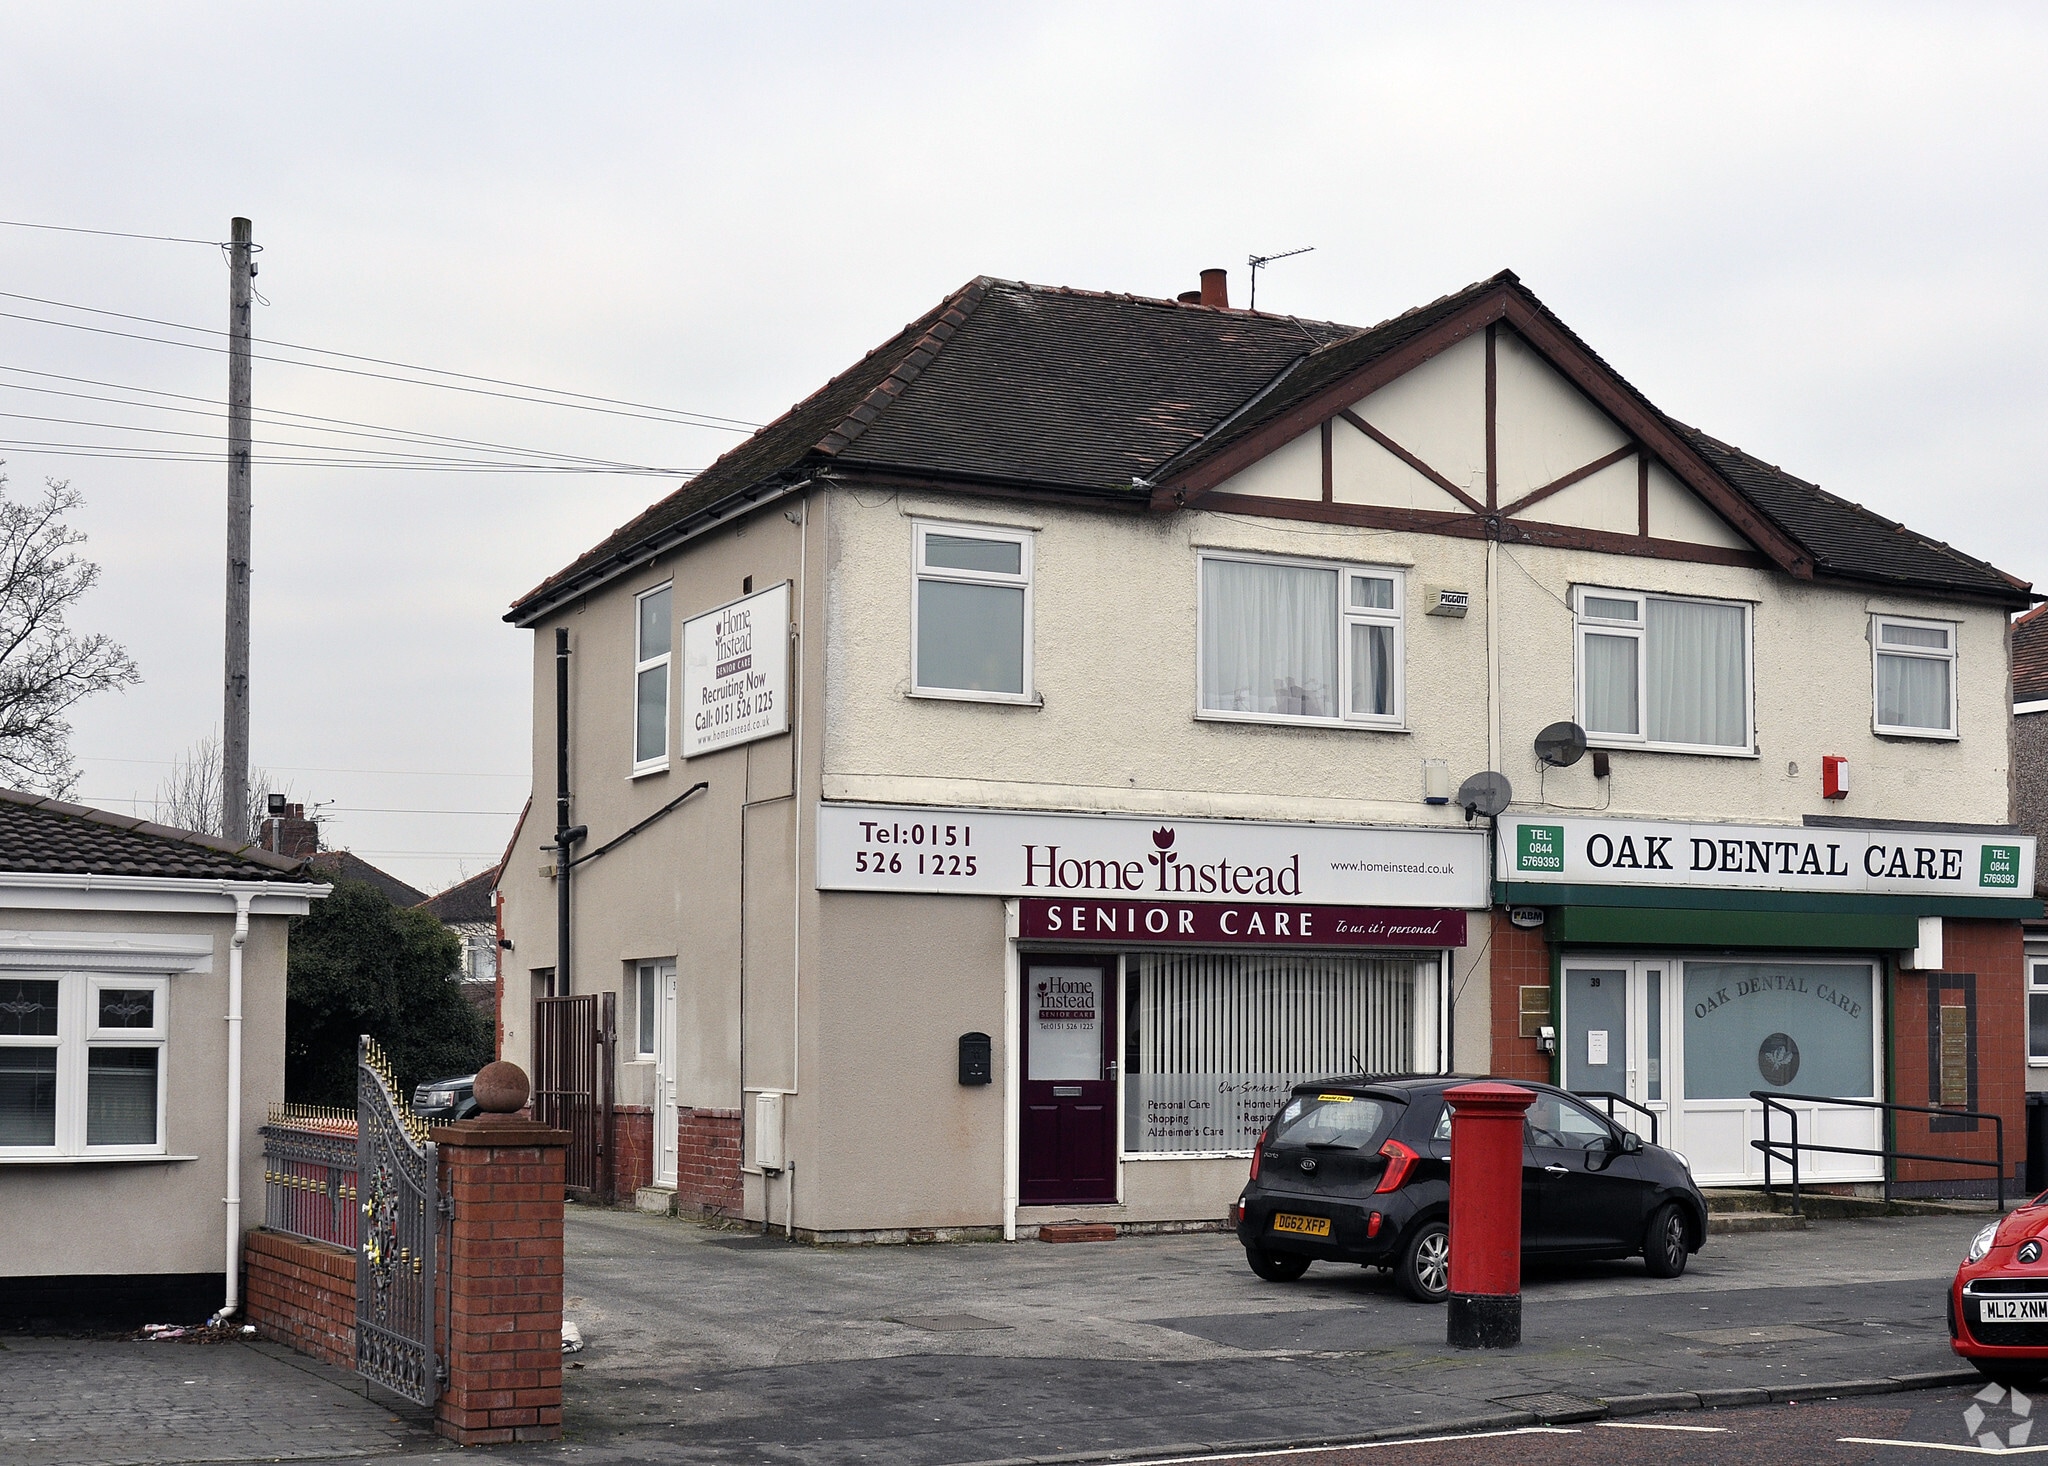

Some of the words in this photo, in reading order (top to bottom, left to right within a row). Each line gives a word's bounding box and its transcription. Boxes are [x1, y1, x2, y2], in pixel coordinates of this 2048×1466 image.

[1441, 594, 1468, 604] PIGGOTT
[722, 609, 751, 637] Home
[715, 624, 752, 661] Instead
[716, 663, 736, 676] SENIOR
[737, 656, 751, 670] CARE
[702, 678, 744, 706] Recruiting
[746, 671, 766, 692] Now
[695, 709, 713, 732] Call:
[715, 702, 734, 726] 0151
[736, 696, 751, 720] 526
[754, 690, 773, 715] 1225
[698, 715, 770, 744] www.homeinstead.co.uk
[859, 821, 971, 847] Tel:0151
[1530, 829, 1552, 841] TEL:
[1529, 842, 1553, 855] 0844
[1586, 832, 1673, 870] OAK
[1689, 837, 1849, 877] DENTAL
[1863, 844, 1963, 881] CARE
[1991, 849, 2010, 860] TEL:
[855, 851, 902, 874] 526
[917, 853, 978, 877] 1225
[1021, 844, 1145, 892] Home
[1150, 850, 1303, 897] Instead
[1330, 858, 1455, 876] www.homeinstead.co.uk
[1522, 856, 1560, 868] 5769393
[1990, 862, 2010, 872] 0844
[1983, 873, 2015, 885] 5769393
[1047, 905, 1195, 935] SENIOR
[1219, 910, 1313, 936] CARE
[1336, 920, 1348, 933] To
[1368, 921, 1386, 934] it's
[1387, 920, 1442, 938] personal
[1049, 976, 1093, 994] Home
[1590, 978, 1601, 988] 39
[1040, 991, 1095, 1009] Instead
[1695, 988, 1731, 1019] OAK
[1736, 975, 1808, 997] DENTAL
[1816, 983, 1862, 1019] CARE
[1040, 1022, 1063, 1030] Tel:0151
[1218, 1081, 1239, 1094] Our
[1240, 1081, 1279, 1095] Services
[1147, 1100, 1186, 1109] Personal
[1188, 1100, 1211, 1109] Care
[1244, 1100, 1271, 1108] Home
[1147, 1114, 1189, 1125] Shopping
[1147, 1127, 1199, 1137] Alzheimer's
[1202, 1127, 1224, 1136] Care
[1279, 1215, 1304, 1230] DG62
[1305, 1218, 1326, 1233] XFP
[1987, 1302, 2017, 1318] ML12
[2020, 1301, 2048, 1318] XNM
